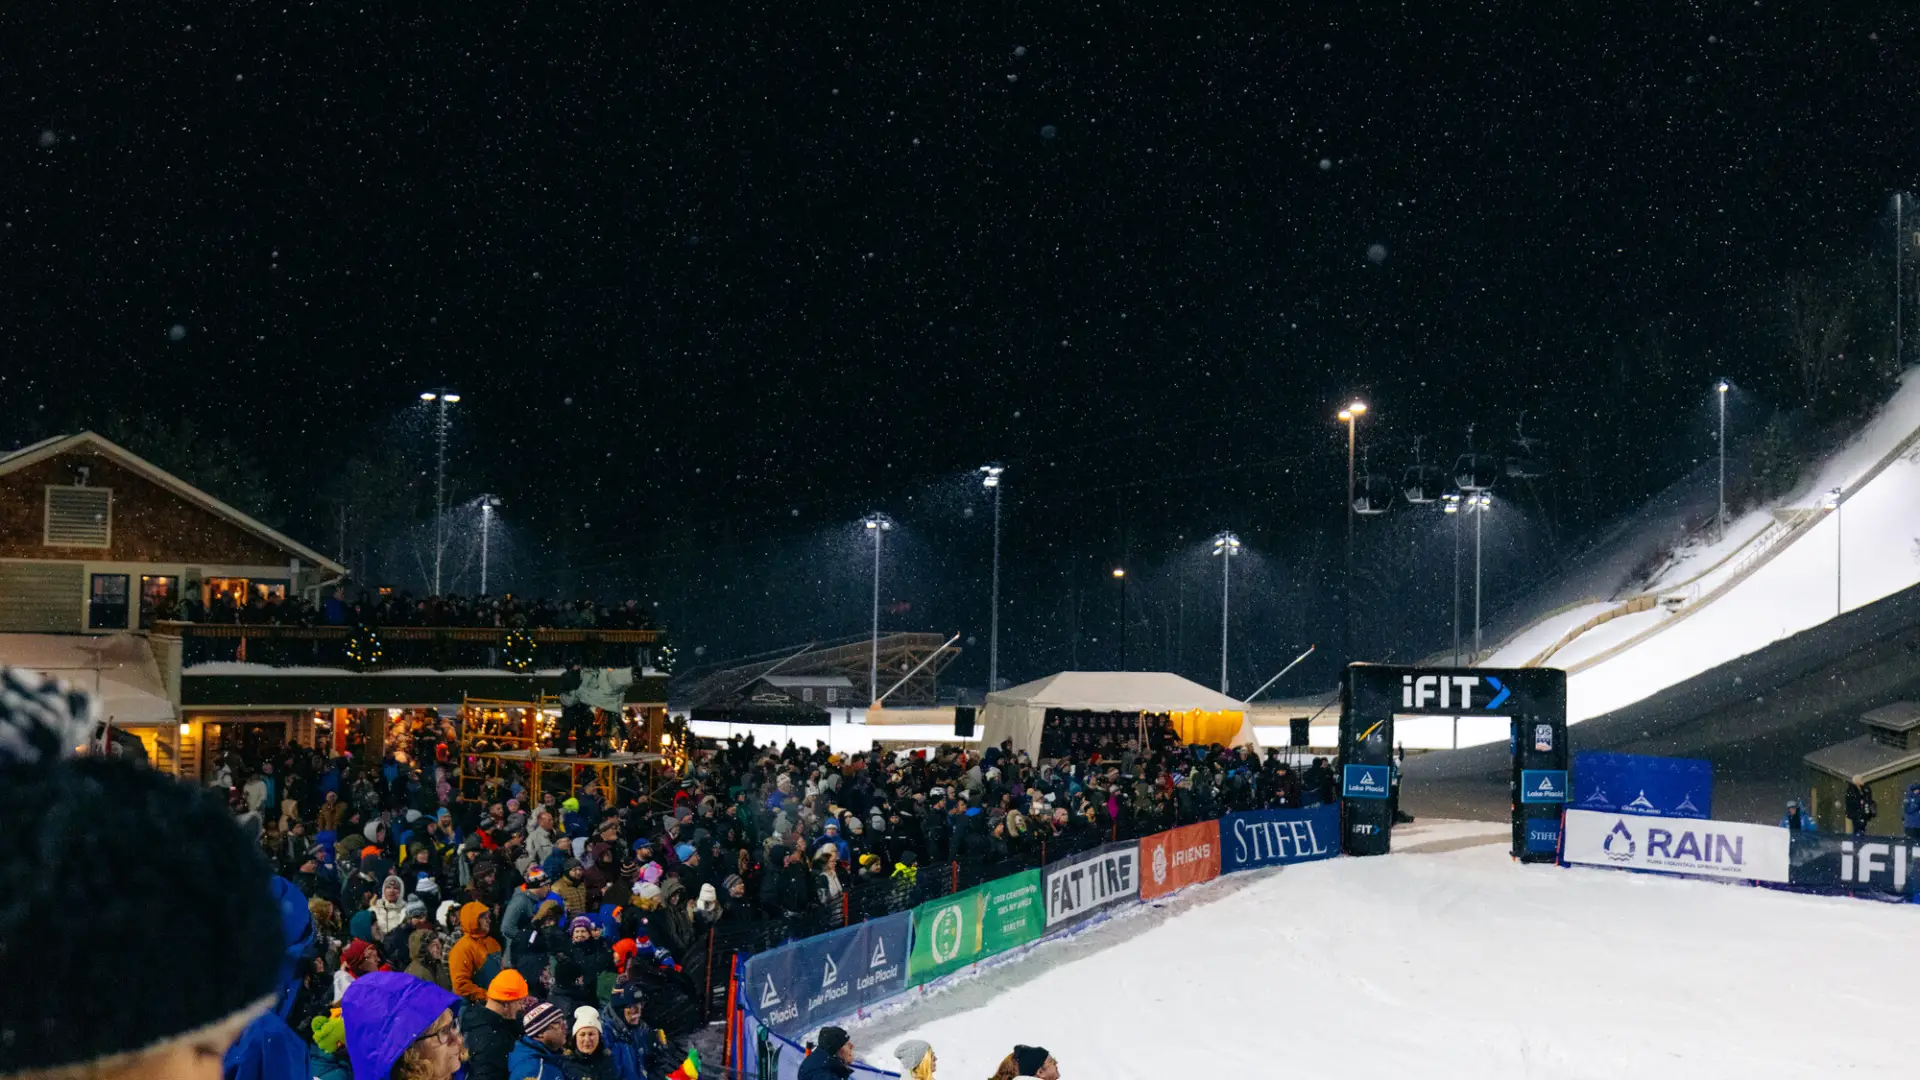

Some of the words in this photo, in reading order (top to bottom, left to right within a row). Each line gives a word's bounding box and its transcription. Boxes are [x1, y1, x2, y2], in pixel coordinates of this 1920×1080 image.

[1402, 675, 1480, 709] iFIT
[1348, 784, 1364, 792] Lake
[1365, 785, 1385, 793] Placid
[1544, 790, 1564, 798] Placid
[1234, 818, 1328, 864] STIFEL
[1352, 825, 1373, 834] iFIT
[1530, 830, 1558, 841] STIFEL
[1647, 828, 1744, 865] RAIN
[1841, 841, 1920, 890] iFI
[1051, 868, 1085, 918] FAT
[1088, 855, 1132, 901] TIRE
[857, 975, 874, 990] Lake
[875, 964, 898, 983] Placid
[825, 981, 849, 1001] Placid
[769, 1002, 798, 1025] Placid
